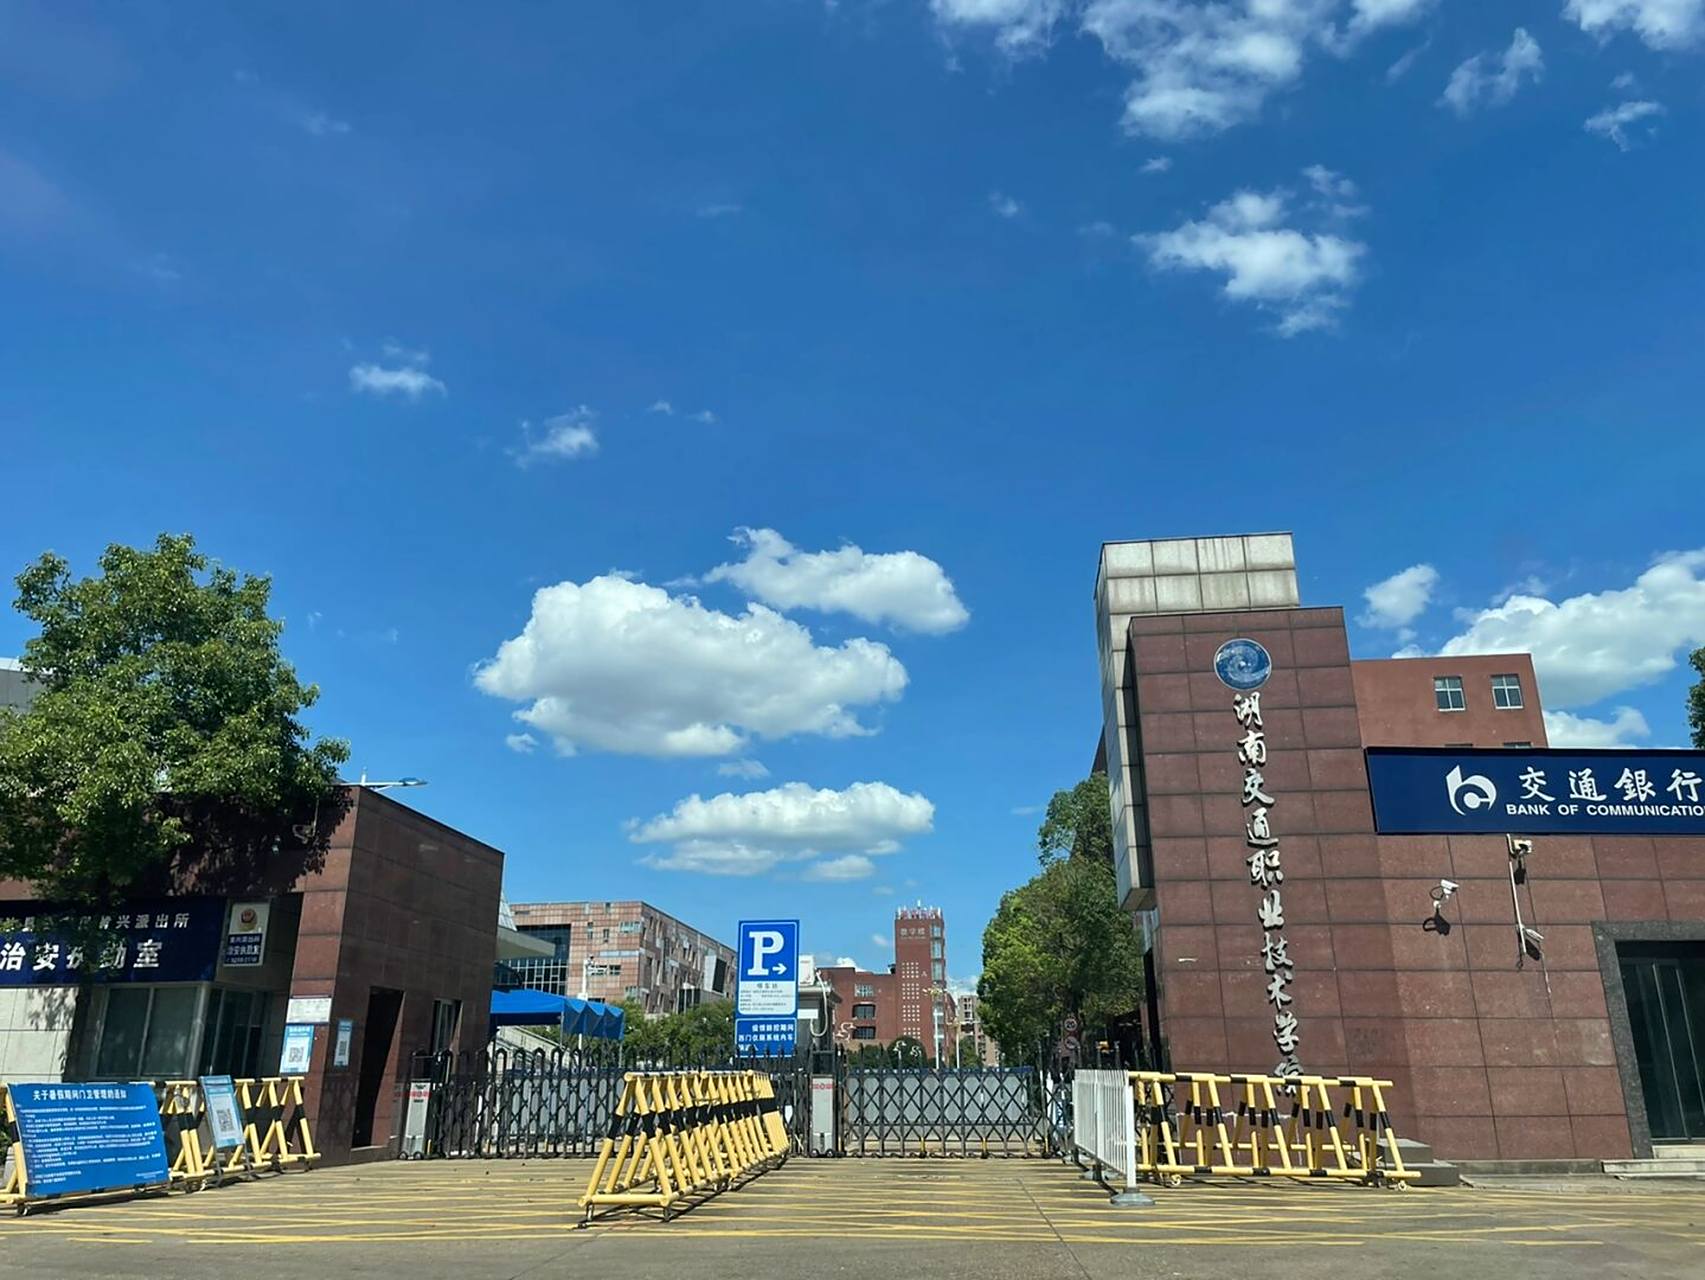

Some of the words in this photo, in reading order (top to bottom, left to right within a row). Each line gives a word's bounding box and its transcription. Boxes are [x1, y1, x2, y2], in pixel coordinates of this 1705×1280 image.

[1506, 804, 1550, 815] BANK
[1558, 804, 1579, 815] OF
[1587, 804, 1705, 816] COMMUNICATIO
[1233, 692, 1304, 1094] 湖南交通职业技术学院
[747, 930, 785, 976] P
